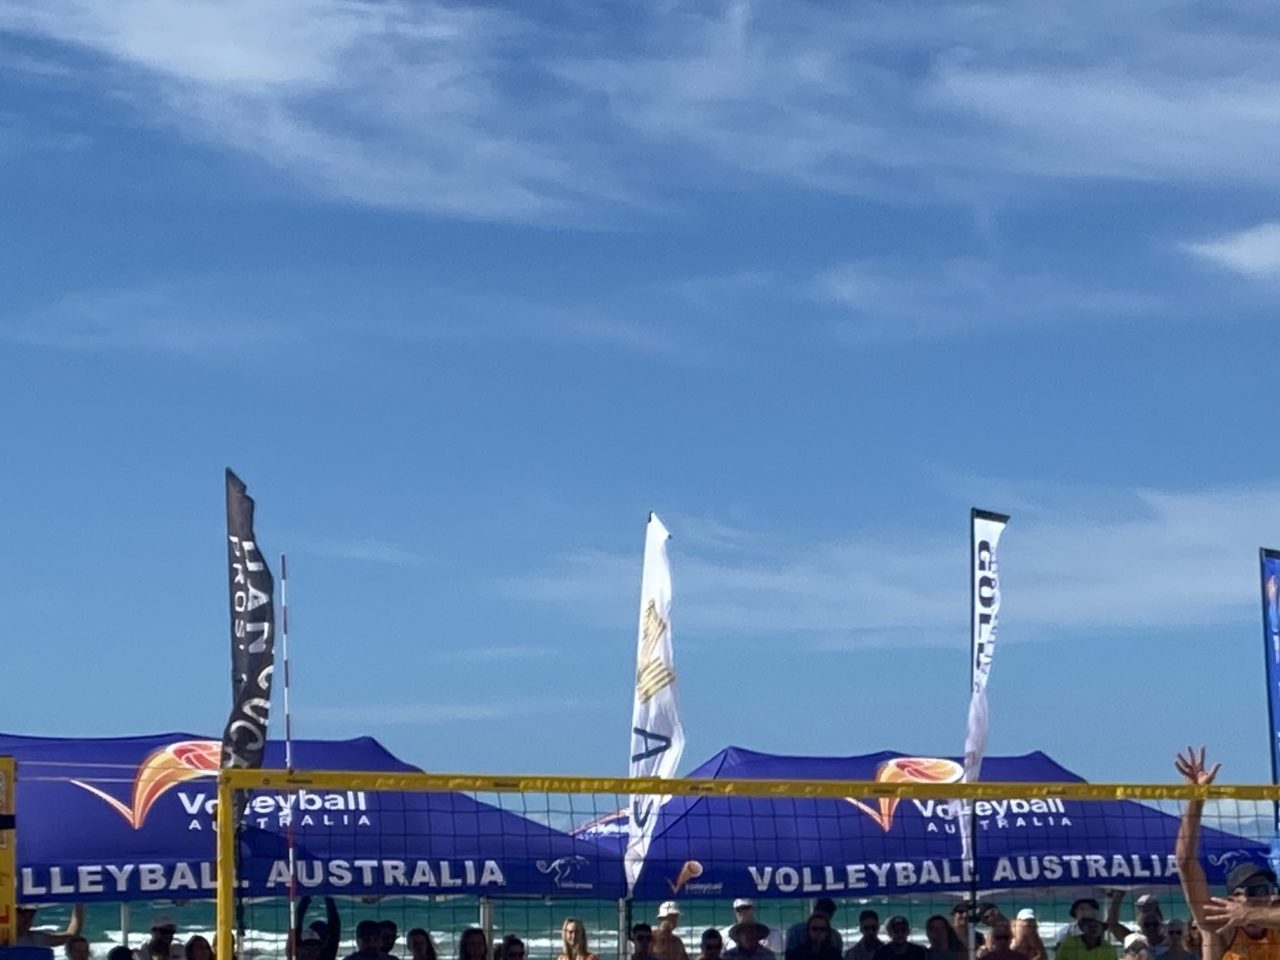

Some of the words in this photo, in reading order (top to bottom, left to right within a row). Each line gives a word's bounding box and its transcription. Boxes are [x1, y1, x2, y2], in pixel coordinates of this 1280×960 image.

[912, 798, 1065, 819] Voeyball
[927, 816, 1072, 834] AUTRALIA
[22, 862, 249, 895] LLEYBAL
[266, 860, 507, 888] AUSTRALIA
